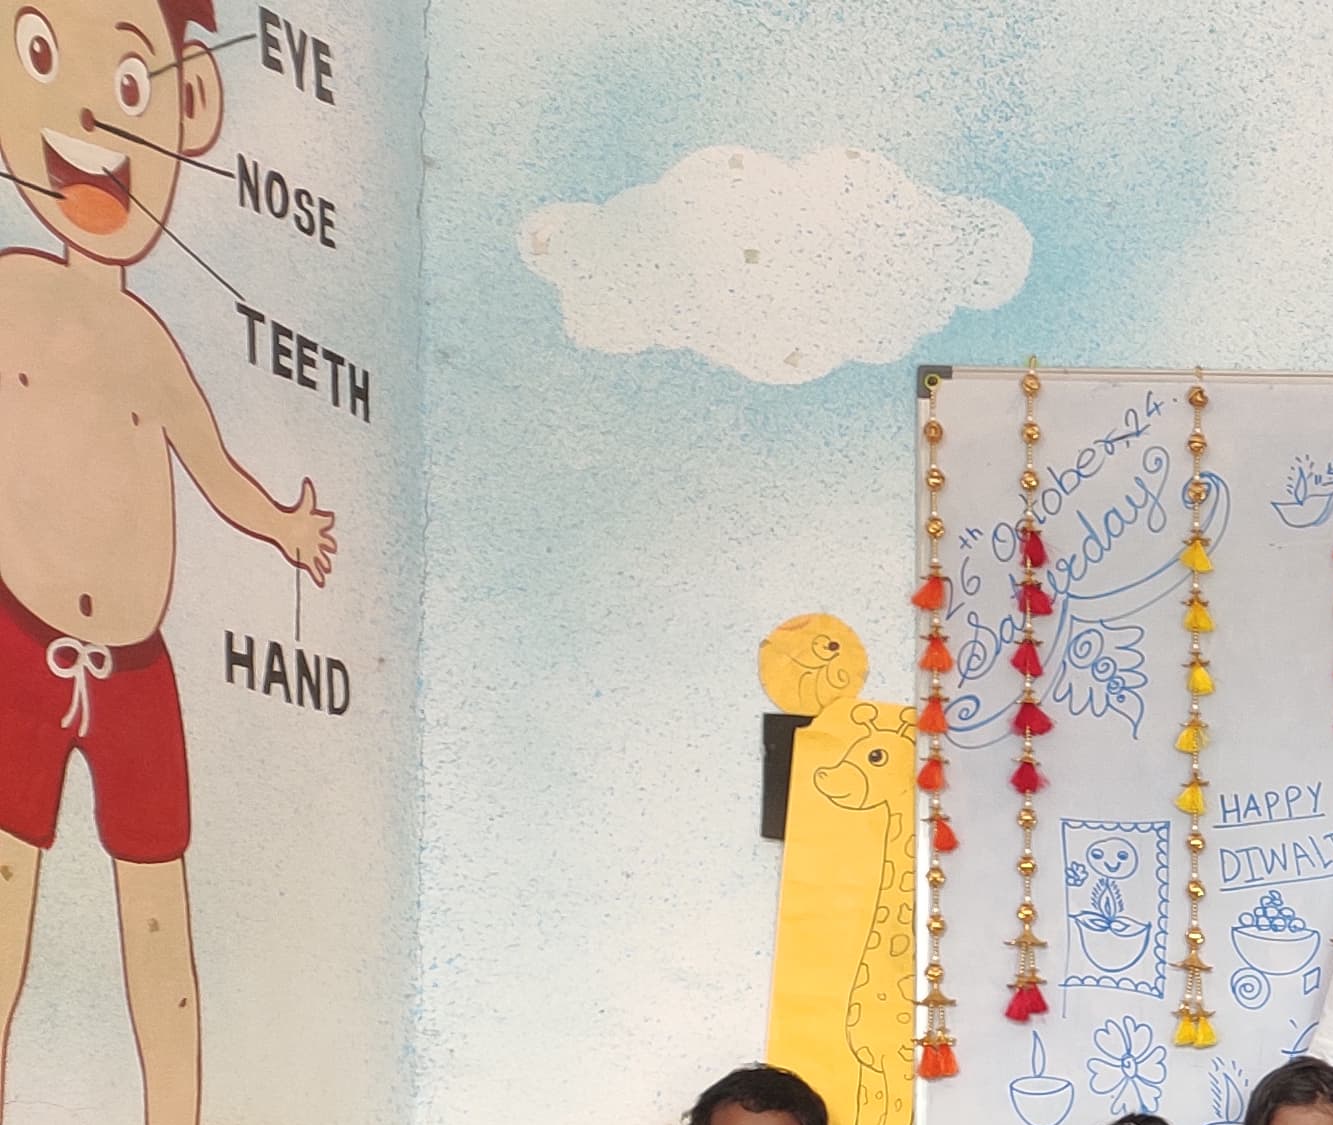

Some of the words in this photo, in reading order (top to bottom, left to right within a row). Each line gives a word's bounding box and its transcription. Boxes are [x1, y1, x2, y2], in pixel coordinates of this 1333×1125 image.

[258, 6, 336, 105] EYE
[236, 153, 337, 250] NOSE
[236, 302, 371, 424] TEETH
[224, 631, 350, 717] HAND
[1219, 781, 1323, 824] HAPPY
